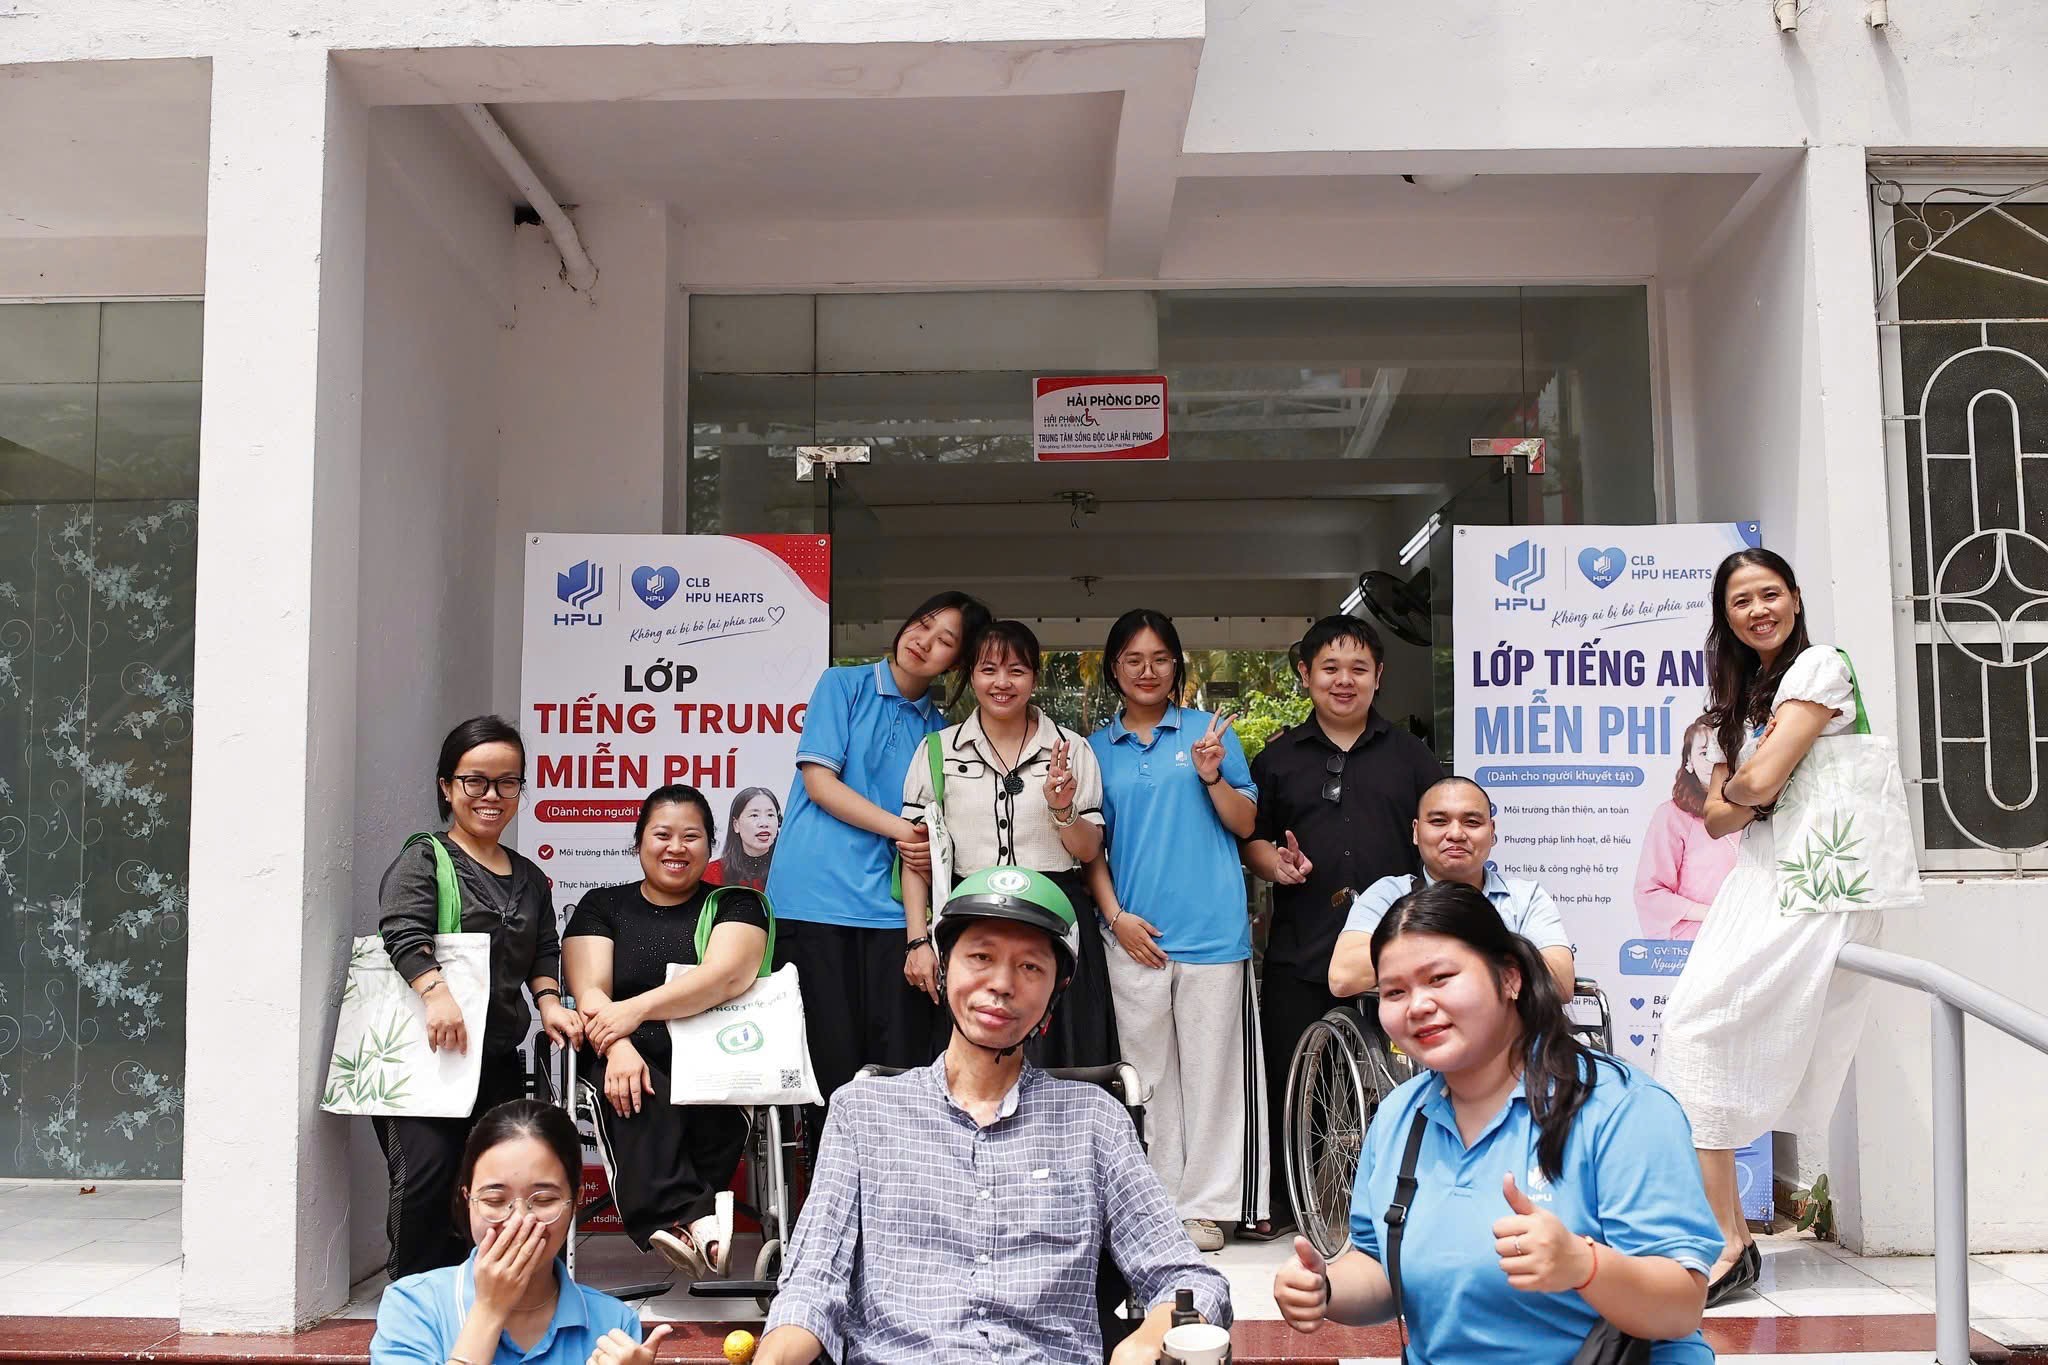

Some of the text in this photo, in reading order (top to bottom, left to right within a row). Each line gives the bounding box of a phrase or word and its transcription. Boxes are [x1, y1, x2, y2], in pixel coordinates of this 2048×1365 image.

[1067, 393, 1160, 407] HẢI PHÒNG DPO
[1039, 433, 1059, 443] TRUNG
[1120, 429, 1131, 441] HẢI
[1631, 555, 1655, 566] CLB
[1631, 568, 1712, 580] HPU HEARTS
[686, 577, 710, 588] CLB
[686, 592, 764, 603] HPU HEARTS
[1495, 598, 1546, 611] HPU
[554, 613, 602, 626] HPU
[1551, 610, 1588, 628] Không
[1592, 611, 1604, 620] ai
[1607, 605, 1618, 620] bị
[1638, 601, 1654, 617] lại
[1686, 600, 1706, 610] sau
[629, 628, 663, 644] Không
[680, 623, 690, 635] bị
[707, 618, 720, 632] lại
[749, 616, 766, 624] sau
[1473, 637, 1713, 688] LỚP TIẾNG AN
[624, 657, 698, 693] LỚP
[533, 692, 656, 734] TIẾNG
[1474, 688, 1676, 755] MIỄN PHÍ
[536, 742, 739, 789] MIỄN PHÍ
[1487, 770, 1634, 783] (Dành cho người khuyết tật)
[546, 806, 579, 818] (Dành
[582, 806, 600, 816] cho
[604, 806, 634, 818] người
[1504, 806, 1520, 814] Môi
[1504, 835, 1536, 846] Phương
[1560, 835, 1575, 844] linh
[1577, 836, 1598, 845] hoạt,
[559, 848, 574, 856] Môi
[1504, 864, 1521, 875] Học
[1522, 864, 1537, 874] liệu
[1548, 864, 1568, 875] công
[1570, 864, 1591, 875] nghệ
[1606, 865, 1619, 875] trợ
[559, 880, 578, 890] Thực
[580, 880, 599, 888] hành
[1560, 894, 1575, 904] học
[1595, 894, 1612, 904] hợp
[1653, 946, 1670, 955] GV:
[1583, 997, 1601, 1006] Phò
[585, 1181, 599, 1192] hệ:
